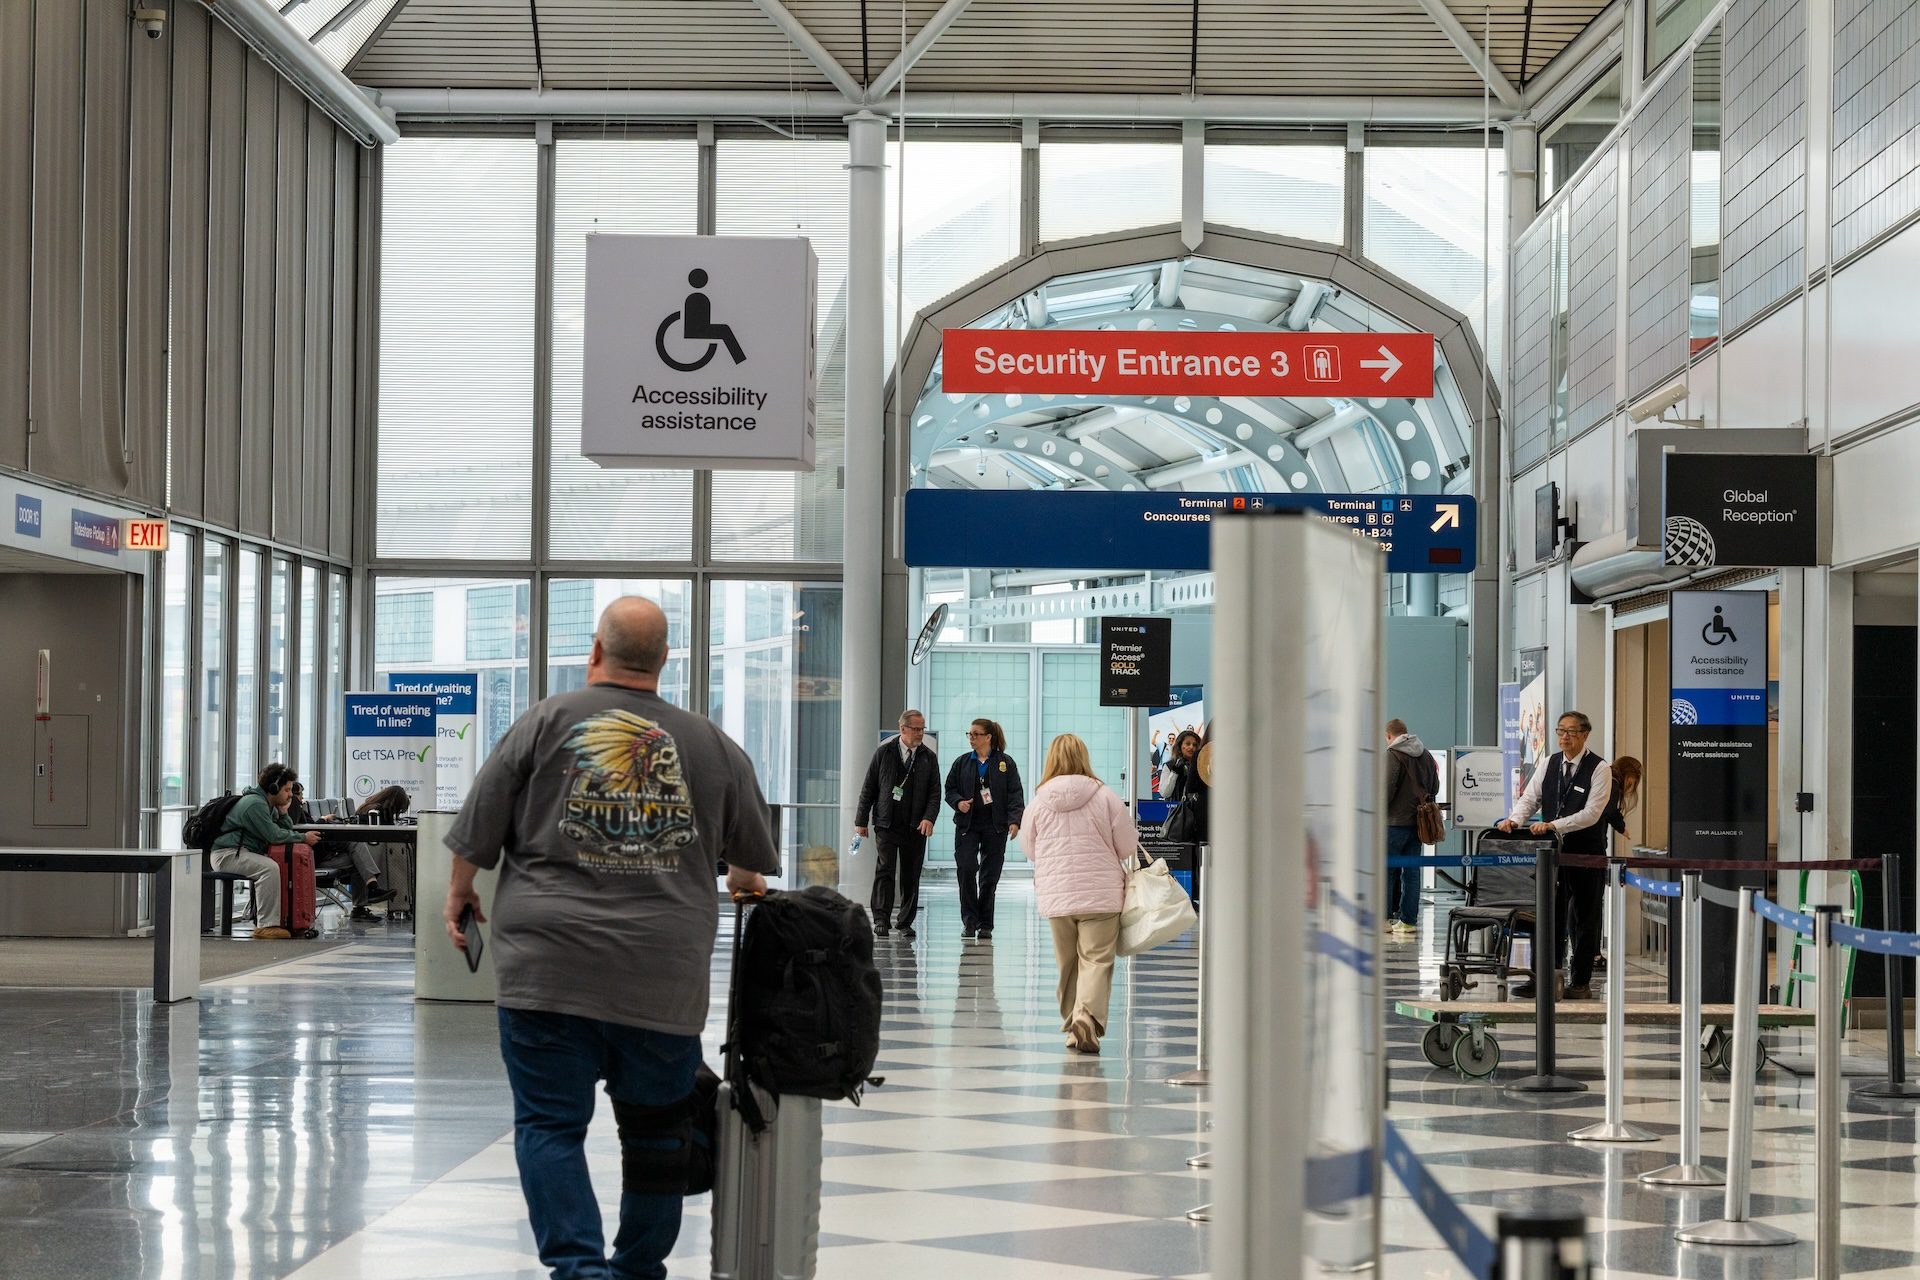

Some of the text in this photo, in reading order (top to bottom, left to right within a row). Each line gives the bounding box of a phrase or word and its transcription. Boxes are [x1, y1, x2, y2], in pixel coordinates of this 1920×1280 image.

[974, 346, 1290, 382] Security Entrance 3
[632, 385, 768, 411] Accessibility
[641, 411, 757, 431] assistance
[1723, 489, 1768, 503] Global
[1179, 498, 1243, 508] Terminal 2
[1327, 500, 1375, 510] Terminal
[19, 507, 33, 524] DOOR
[1143, 511, 1211, 522] Concourses
[1368, 514, 1377, 523] B
[1383, 514, 1392, 523] C
[74, 521, 105, 545] Rideshare Pickup
[130, 523, 163, 546] EXIT
[1111, 643, 1143, 652] Premier
[1111, 661, 1136, 669] GOLD
[1690, 655, 1749, 667] Accessibility
[1695, 667, 1745, 676] assistance
[394, 683, 472, 695] Tired of waiting
[352, 704, 431, 717] Tired of waiting
[376, 717, 412, 727] in line?
[437, 727, 456, 738] Pre
[1682, 740, 1719, 748] Wheelchair
[352, 749, 416, 761] Get TSA Pre
[1682, 751, 1705, 759] Airport
[567, 801, 693, 837] STURGIS
[1497, 855, 1511, 863] TSA
